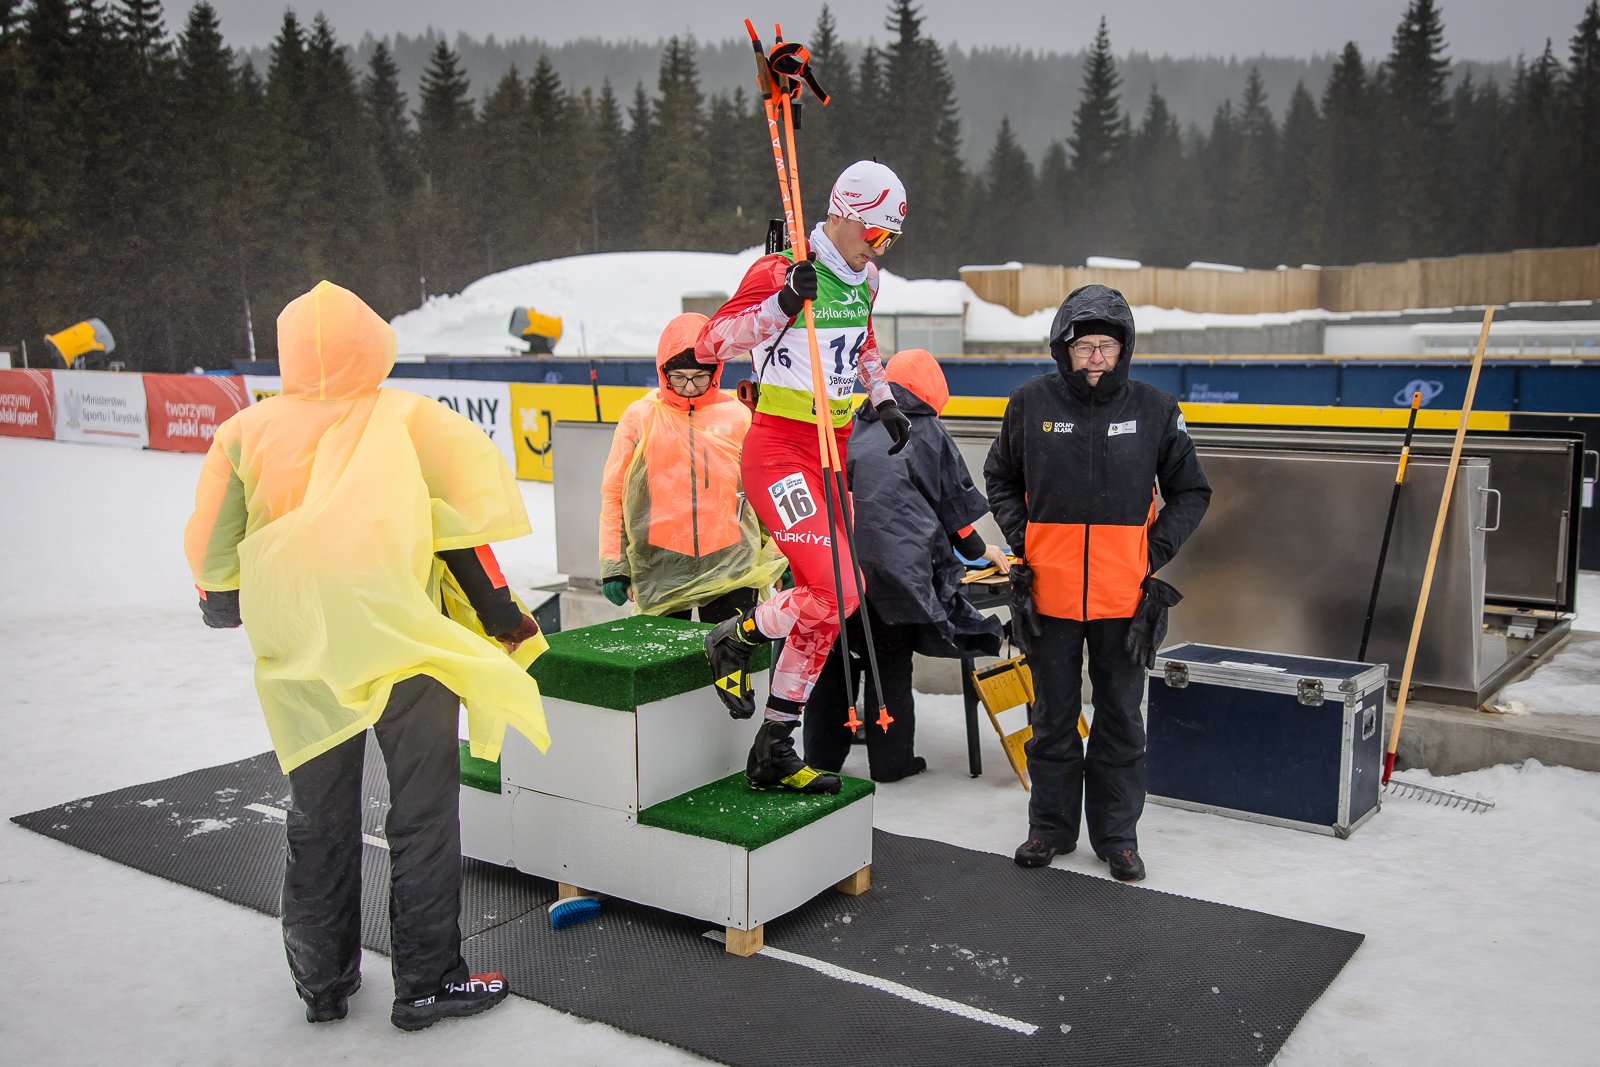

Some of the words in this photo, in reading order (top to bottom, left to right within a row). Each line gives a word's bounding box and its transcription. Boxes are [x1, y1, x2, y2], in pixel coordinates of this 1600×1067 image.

[767, 117, 786, 173] WAY
[783, 193, 799, 246] ONE
[764, 345, 792, 370] 16
[82, 393, 127, 408] Ministerstwo
[165, 400, 216, 421] tworzymy
[17, 410, 38, 428] sport
[82, 407, 107, 423] Sportu
[166, 417, 199, 439] polski
[200, 423, 219, 442] spo
[779, 487, 815, 524] 16
[773, 528, 832, 547] TÜRKİYE
